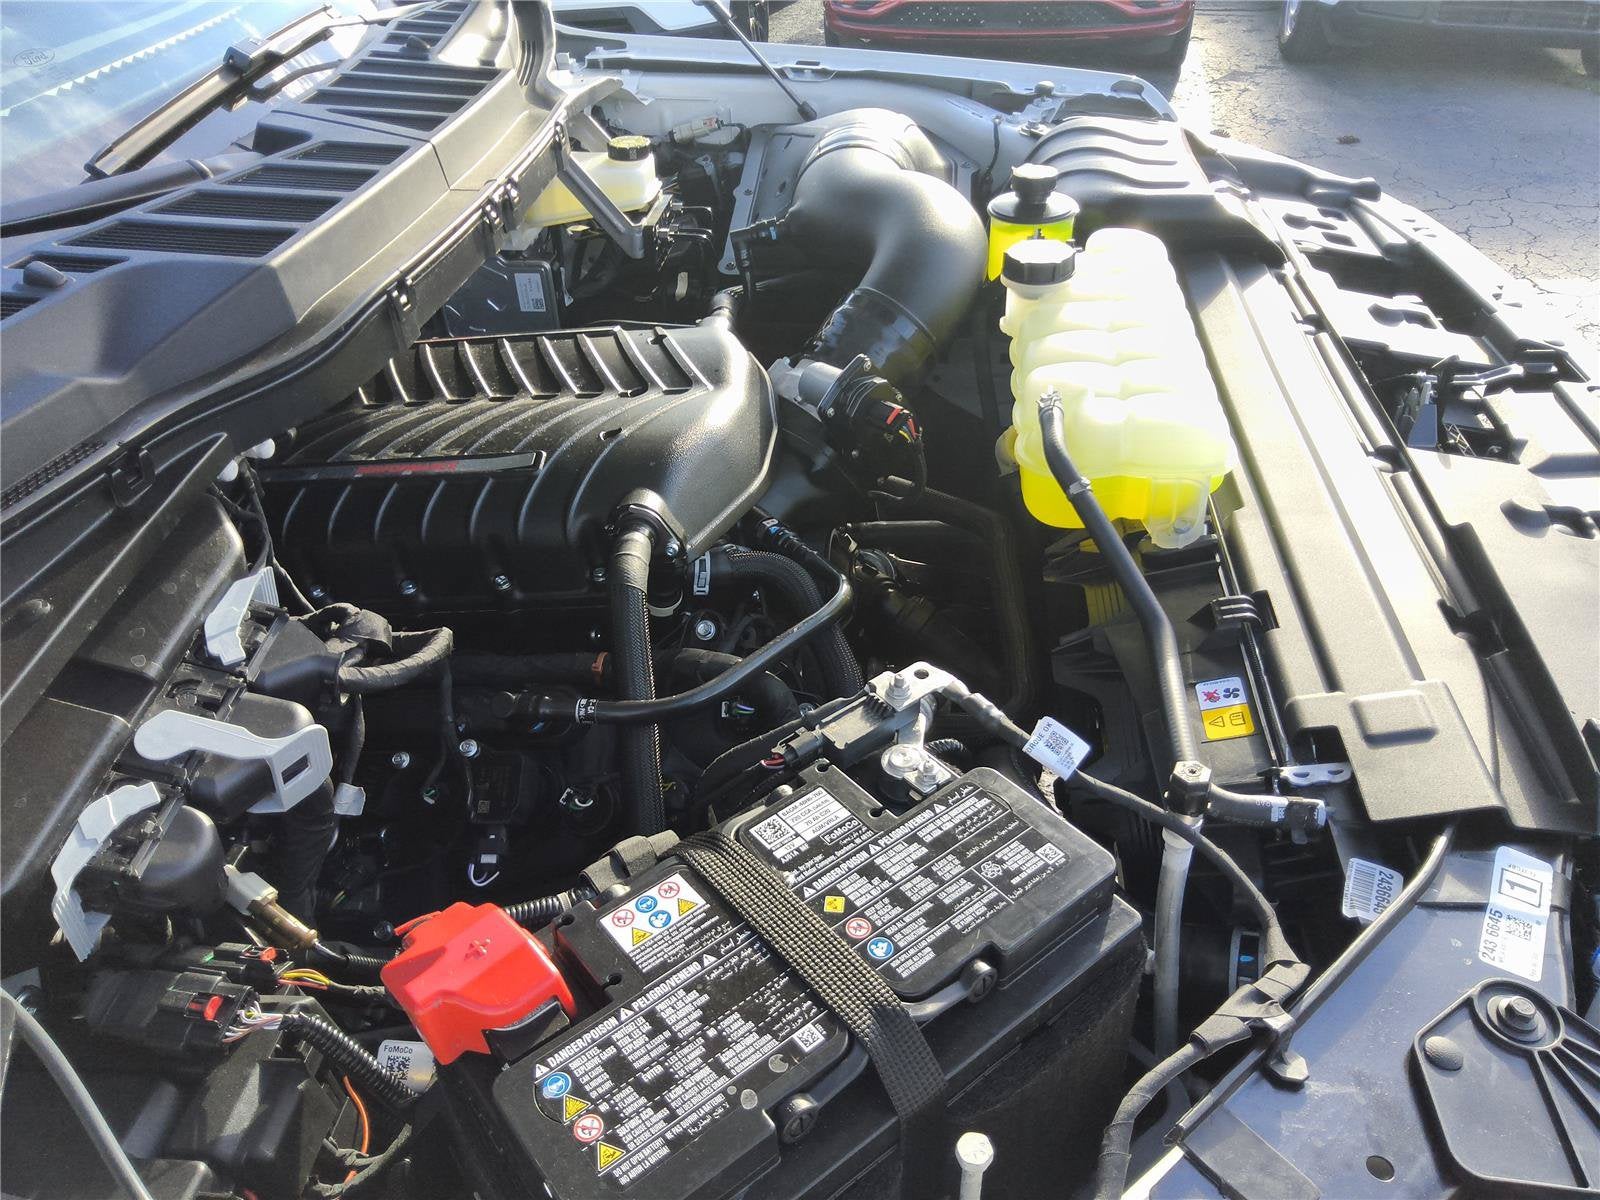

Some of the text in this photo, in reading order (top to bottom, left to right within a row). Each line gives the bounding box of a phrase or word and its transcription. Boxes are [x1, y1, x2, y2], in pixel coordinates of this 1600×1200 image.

[823, 817, 860, 843] FoMoCo
[811, 849, 871, 891] DANGER/POISON
[877, 808, 936, 849] PELIGRO/VENENO
[1504, 879, 1538, 893] 1
[1485, 908, 1503, 938] 6645
[1481, 939, 1498, 961] 243
[546, 1014, 620, 1069] DANGER/POISON
[631, 959, 703, 1013] PELIGRO/VENENO
[706, 1026, 718, 1038] NO
[384, 1045, 413, 1054] FoMoCo
[612, 1085, 635, 1103] SPARKS
[598, 1101, 610, 1113] NO
[622, 1096, 648, 1117] SMOKING
